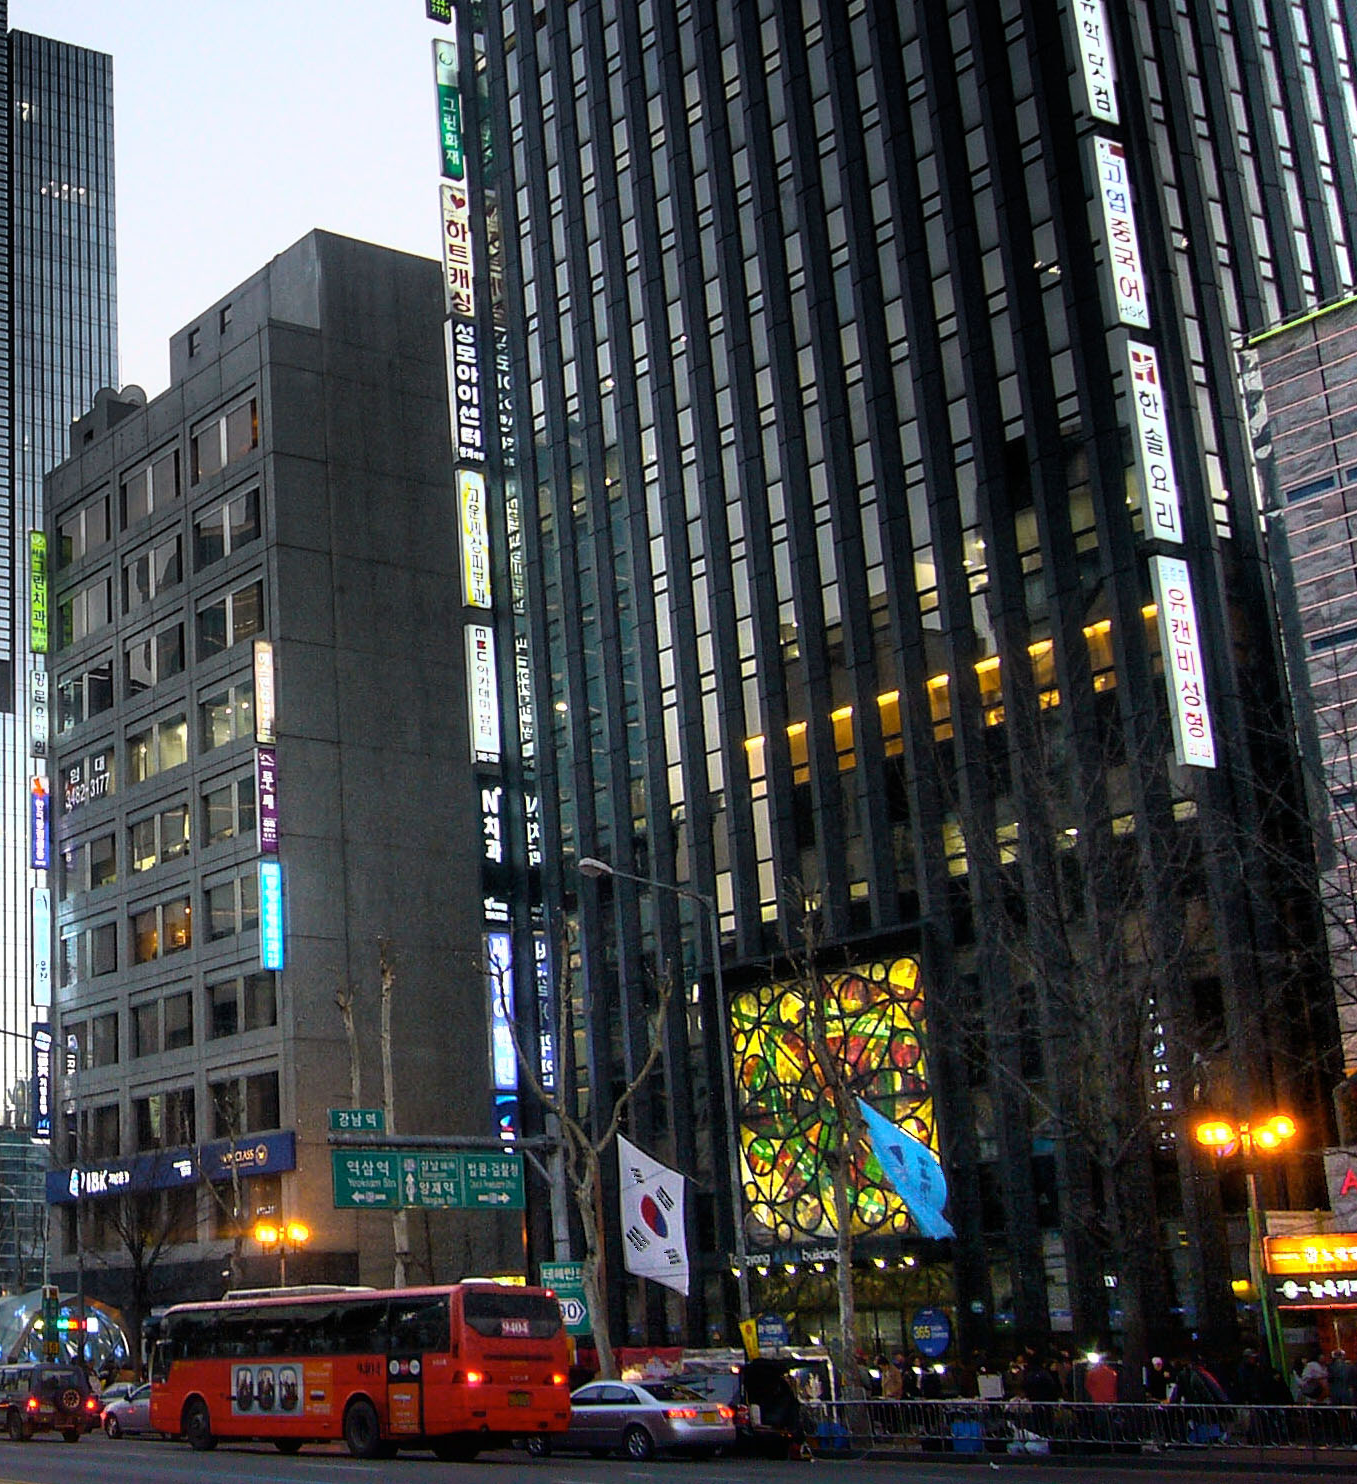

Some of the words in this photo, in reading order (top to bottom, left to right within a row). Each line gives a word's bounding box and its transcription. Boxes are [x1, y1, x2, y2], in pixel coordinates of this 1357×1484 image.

[455, 323, 482, 448] 성모아이센터
[1138, 389, 1176, 534] 한솔요리
[338, 1112, 377, 1128] 강남역
[346, 1160, 390, 1176] 역삼역
[419, 1181, 454, 1195] 양재역
[802, 1247, 840, 1263] building
[502, 1320, 529, 1335] 9404
